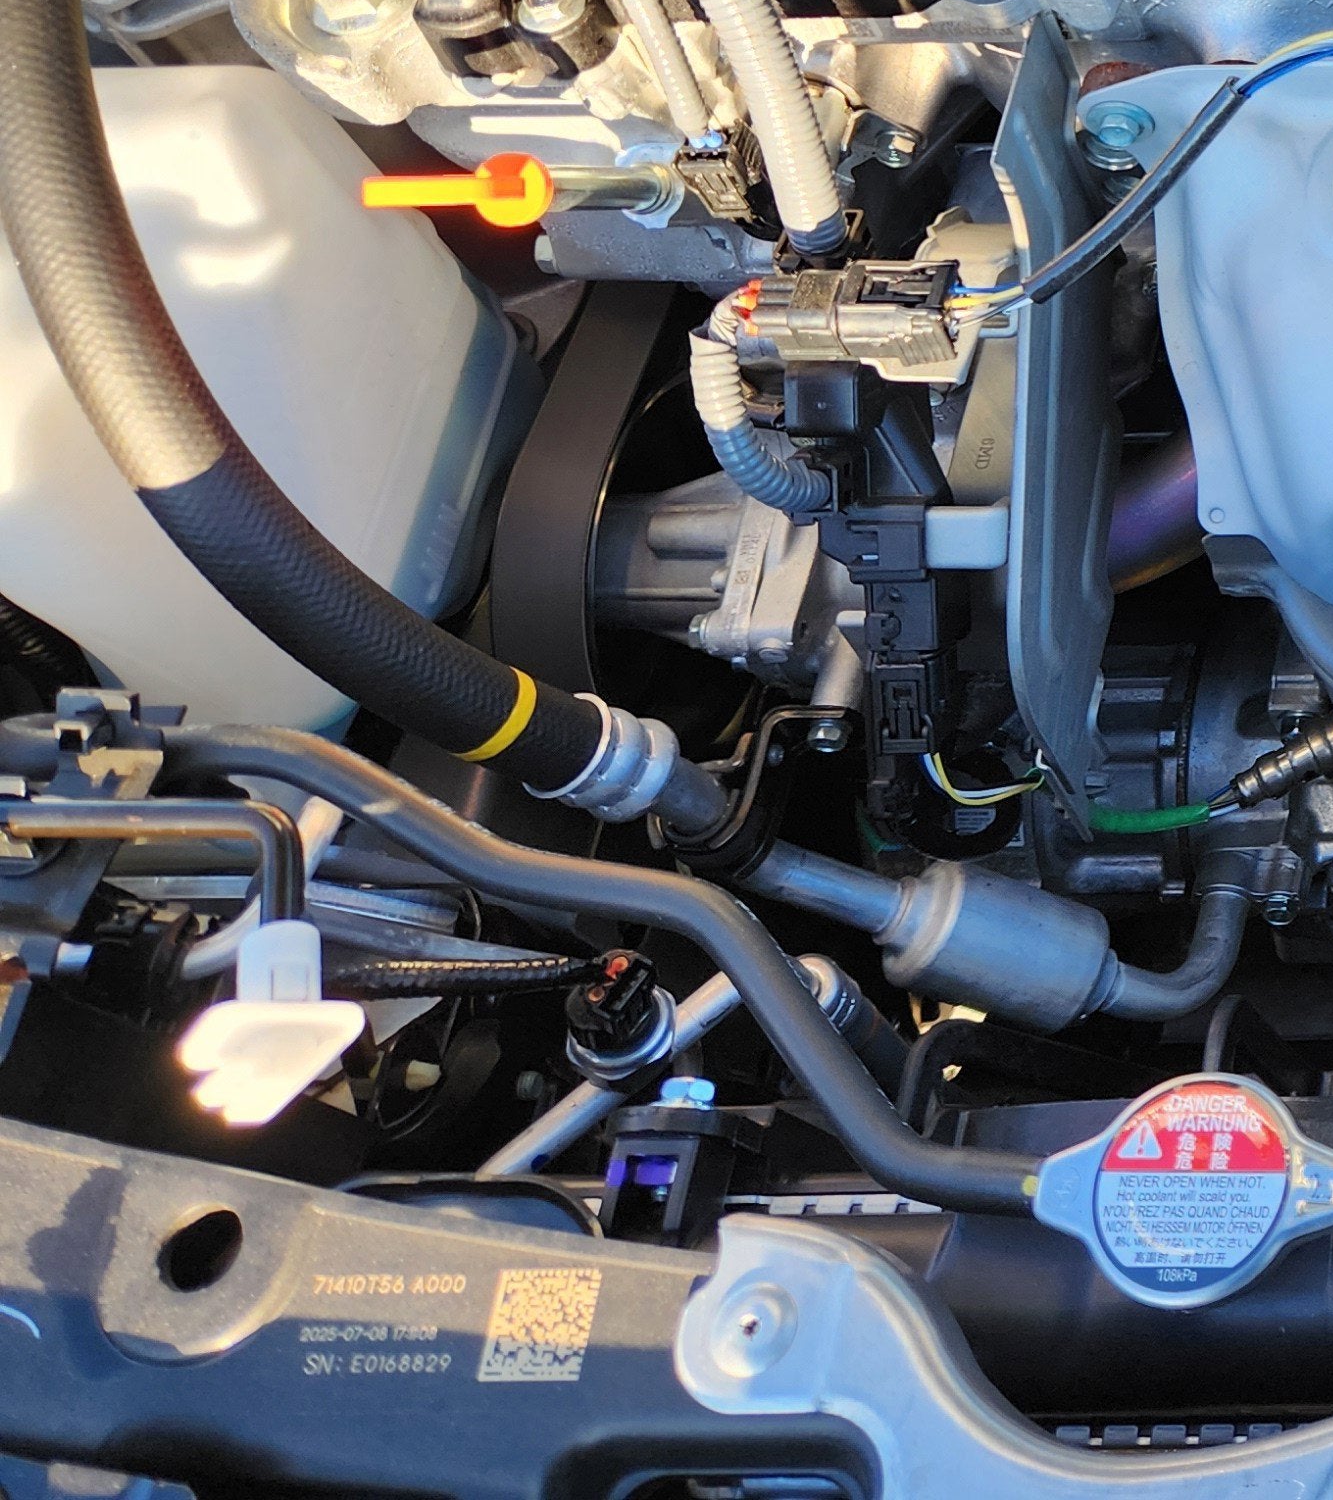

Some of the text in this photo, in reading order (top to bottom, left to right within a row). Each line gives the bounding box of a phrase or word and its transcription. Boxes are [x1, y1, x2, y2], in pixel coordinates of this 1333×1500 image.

[1169, 1094, 1248, 1113] DANGER
[1167, 1113, 1263, 1133] WARNUNG
[1119, 1175, 1267, 1189] NEVER OPEN WHEN HOT.
[1117, 1191, 1137, 1202] Hot
[1138, 1191, 1178, 1202] coolant
[1179, 1190, 1196, 1202] will
[1199, 1191, 1227, 1202] scald
[1162, 1205, 1185, 1219] PAS
[1187, 1205, 1228, 1219] QUAND
[1193, 1221, 1226, 1234] MOTOR
[1156, 1269, 1198, 1283] 108kPa
[312, 1274, 467, 1296] 71410T56 A000
[303, 1351, 452, 1376] SN: E0168829
